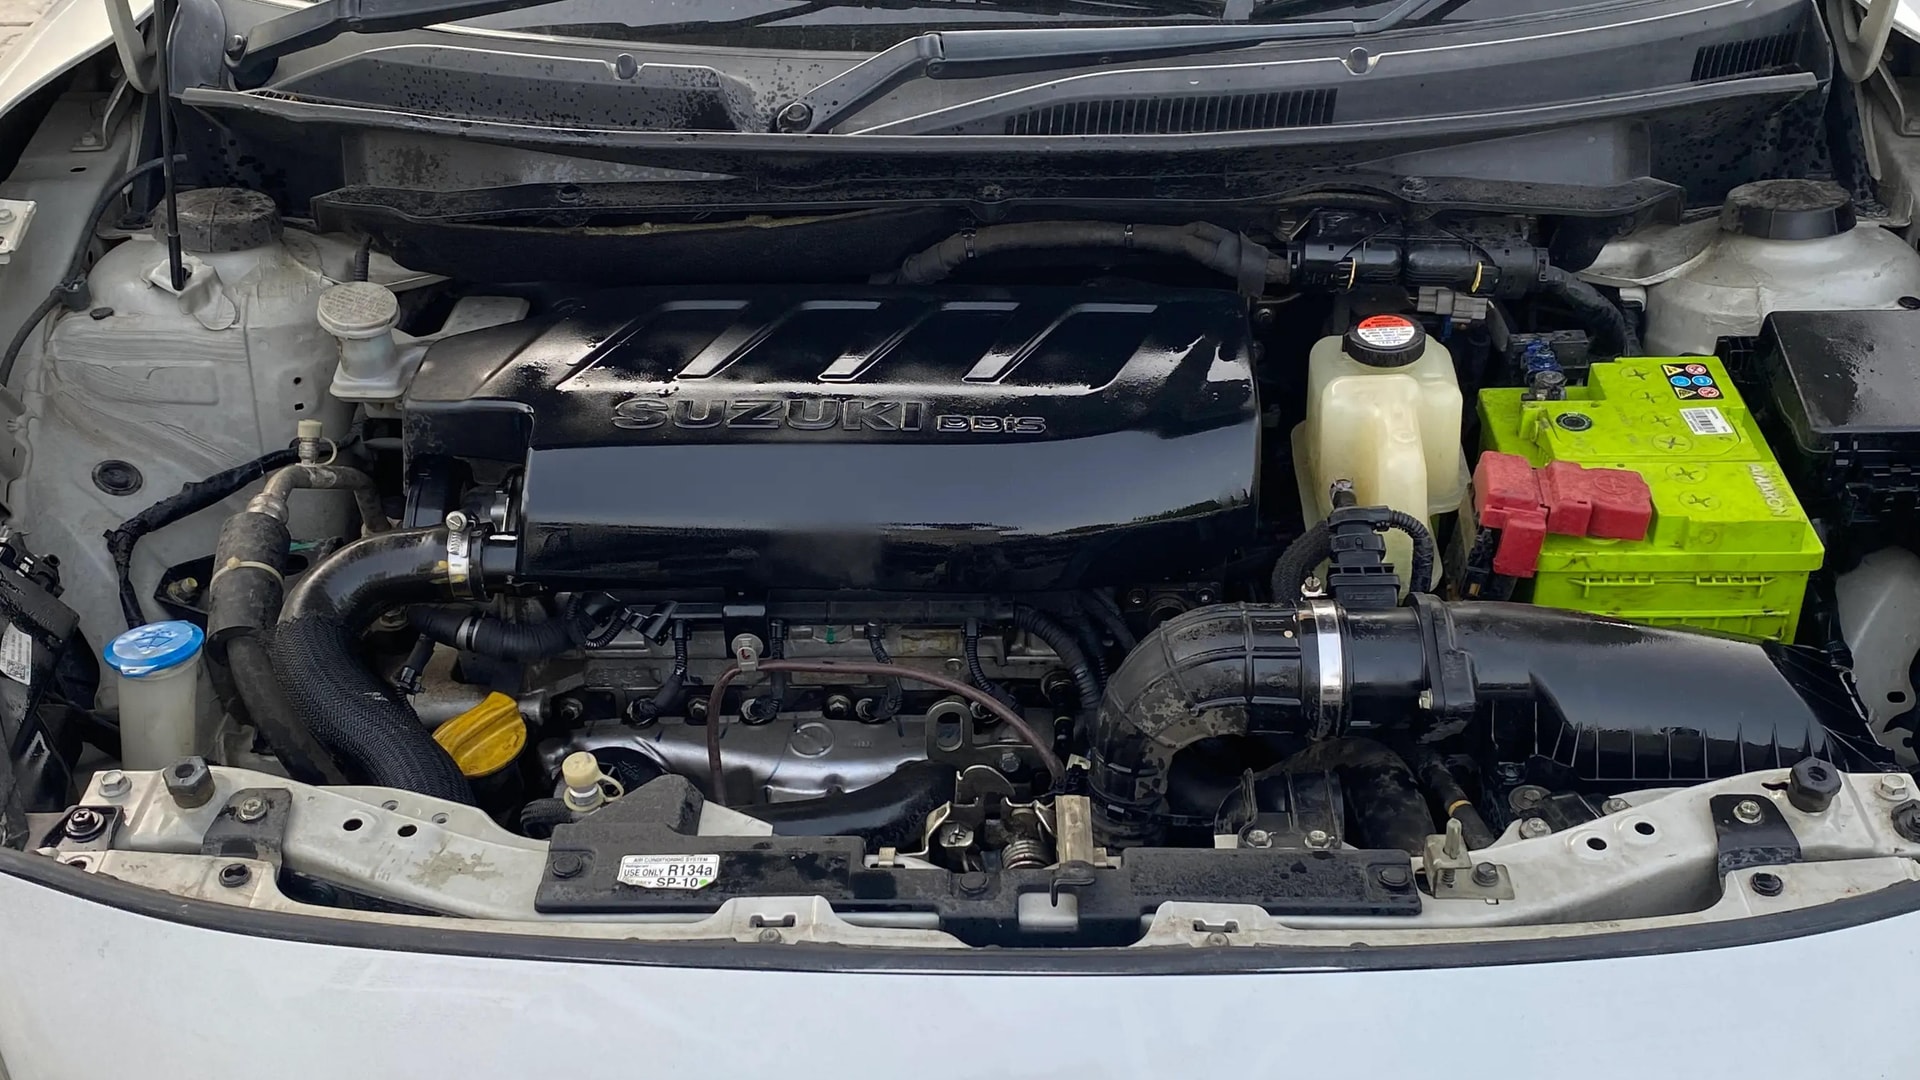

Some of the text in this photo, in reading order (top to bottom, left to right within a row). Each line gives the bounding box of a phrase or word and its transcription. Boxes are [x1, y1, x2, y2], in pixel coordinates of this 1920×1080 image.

[611, 399, 923, 431] SUZUKI
[1746, 463, 1791, 518] AMARON
[624, 864, 713, 877] USE ONLY R134a
[656, 877, 698, 888] SP-10
